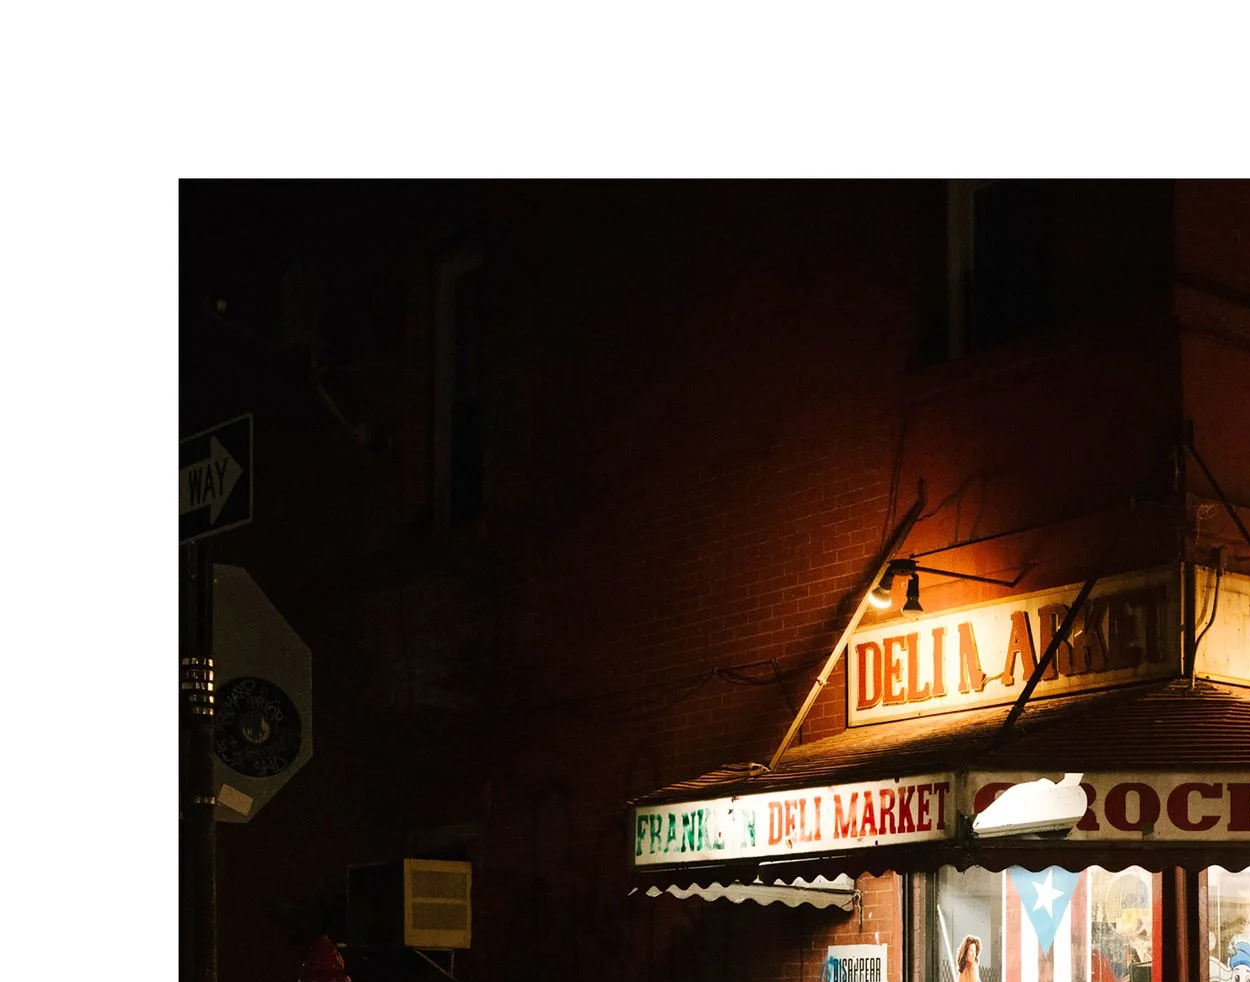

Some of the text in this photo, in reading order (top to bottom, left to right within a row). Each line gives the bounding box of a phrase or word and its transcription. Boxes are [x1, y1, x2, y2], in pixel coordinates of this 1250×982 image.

[189, 457, 229, 506] WAY
[856, 627, 948, 711] DELI
[636, 781, 950, 857] FRANKLN DELI MARKET
